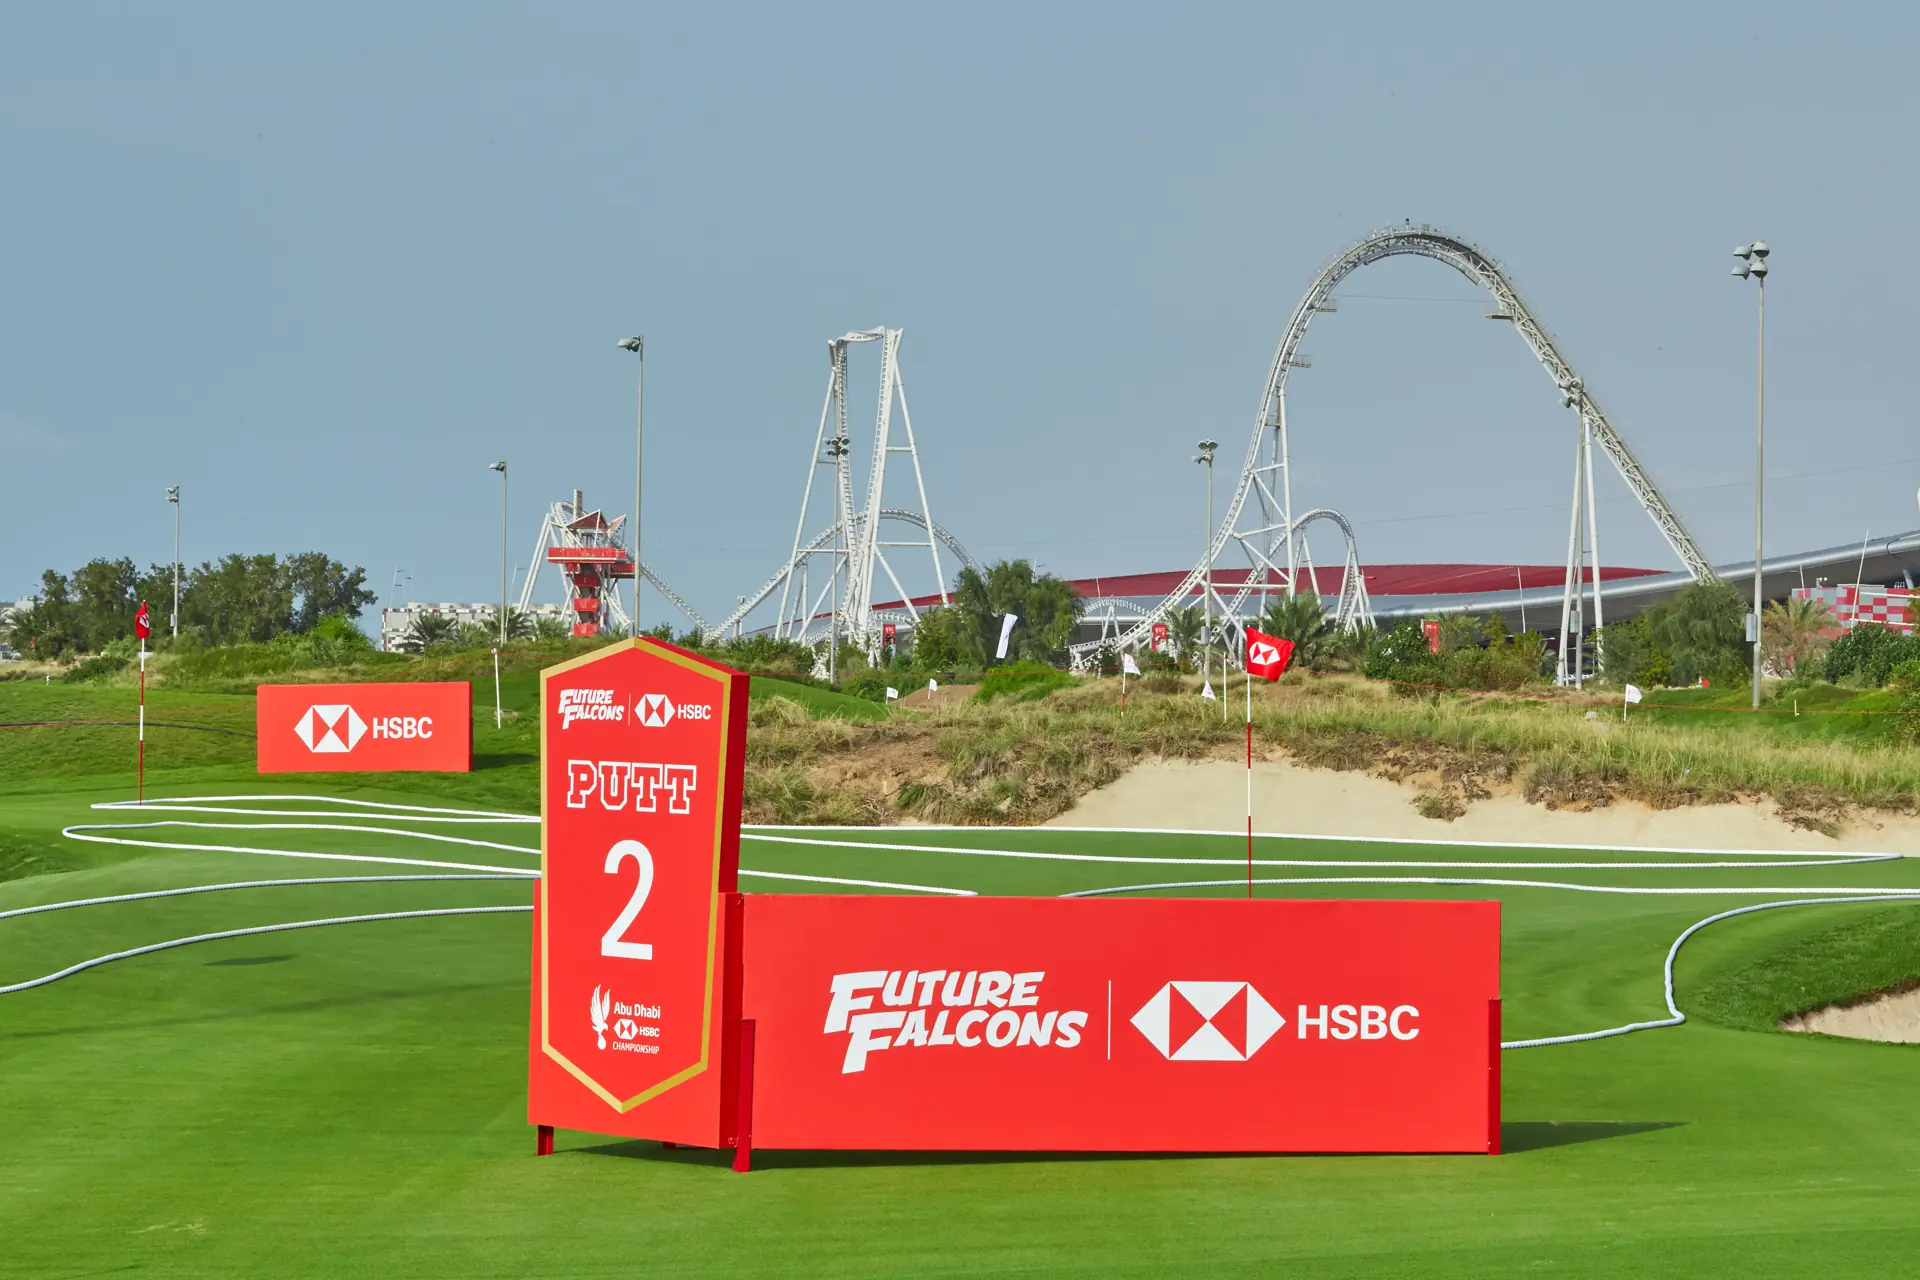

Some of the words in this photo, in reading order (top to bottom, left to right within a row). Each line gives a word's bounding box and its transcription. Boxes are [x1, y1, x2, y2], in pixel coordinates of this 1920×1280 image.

[558, 689, 614, 713] FUTURE
[677, 703, 712, 720] HSBC
[373, 716, 433, 740] HSBC
[562, 704, 625, 730] FALCONS
[567, 759, 697, 814] PUTT
[600, 840, 655, 961] 2
[613, 1001, 633, 1016] Abu
[634, 1003, 661, 1019] Dhabi
[823, 970, 1045, 1034] FUTURE
[639, 1025, 660, 1038] HSBC
[1297, 1004, 1420, 1041] HSBC
[612, 1041, 660, 1055] CHAMPIONSHIP
[841, 1009, 1089, 1074] FALCONS
